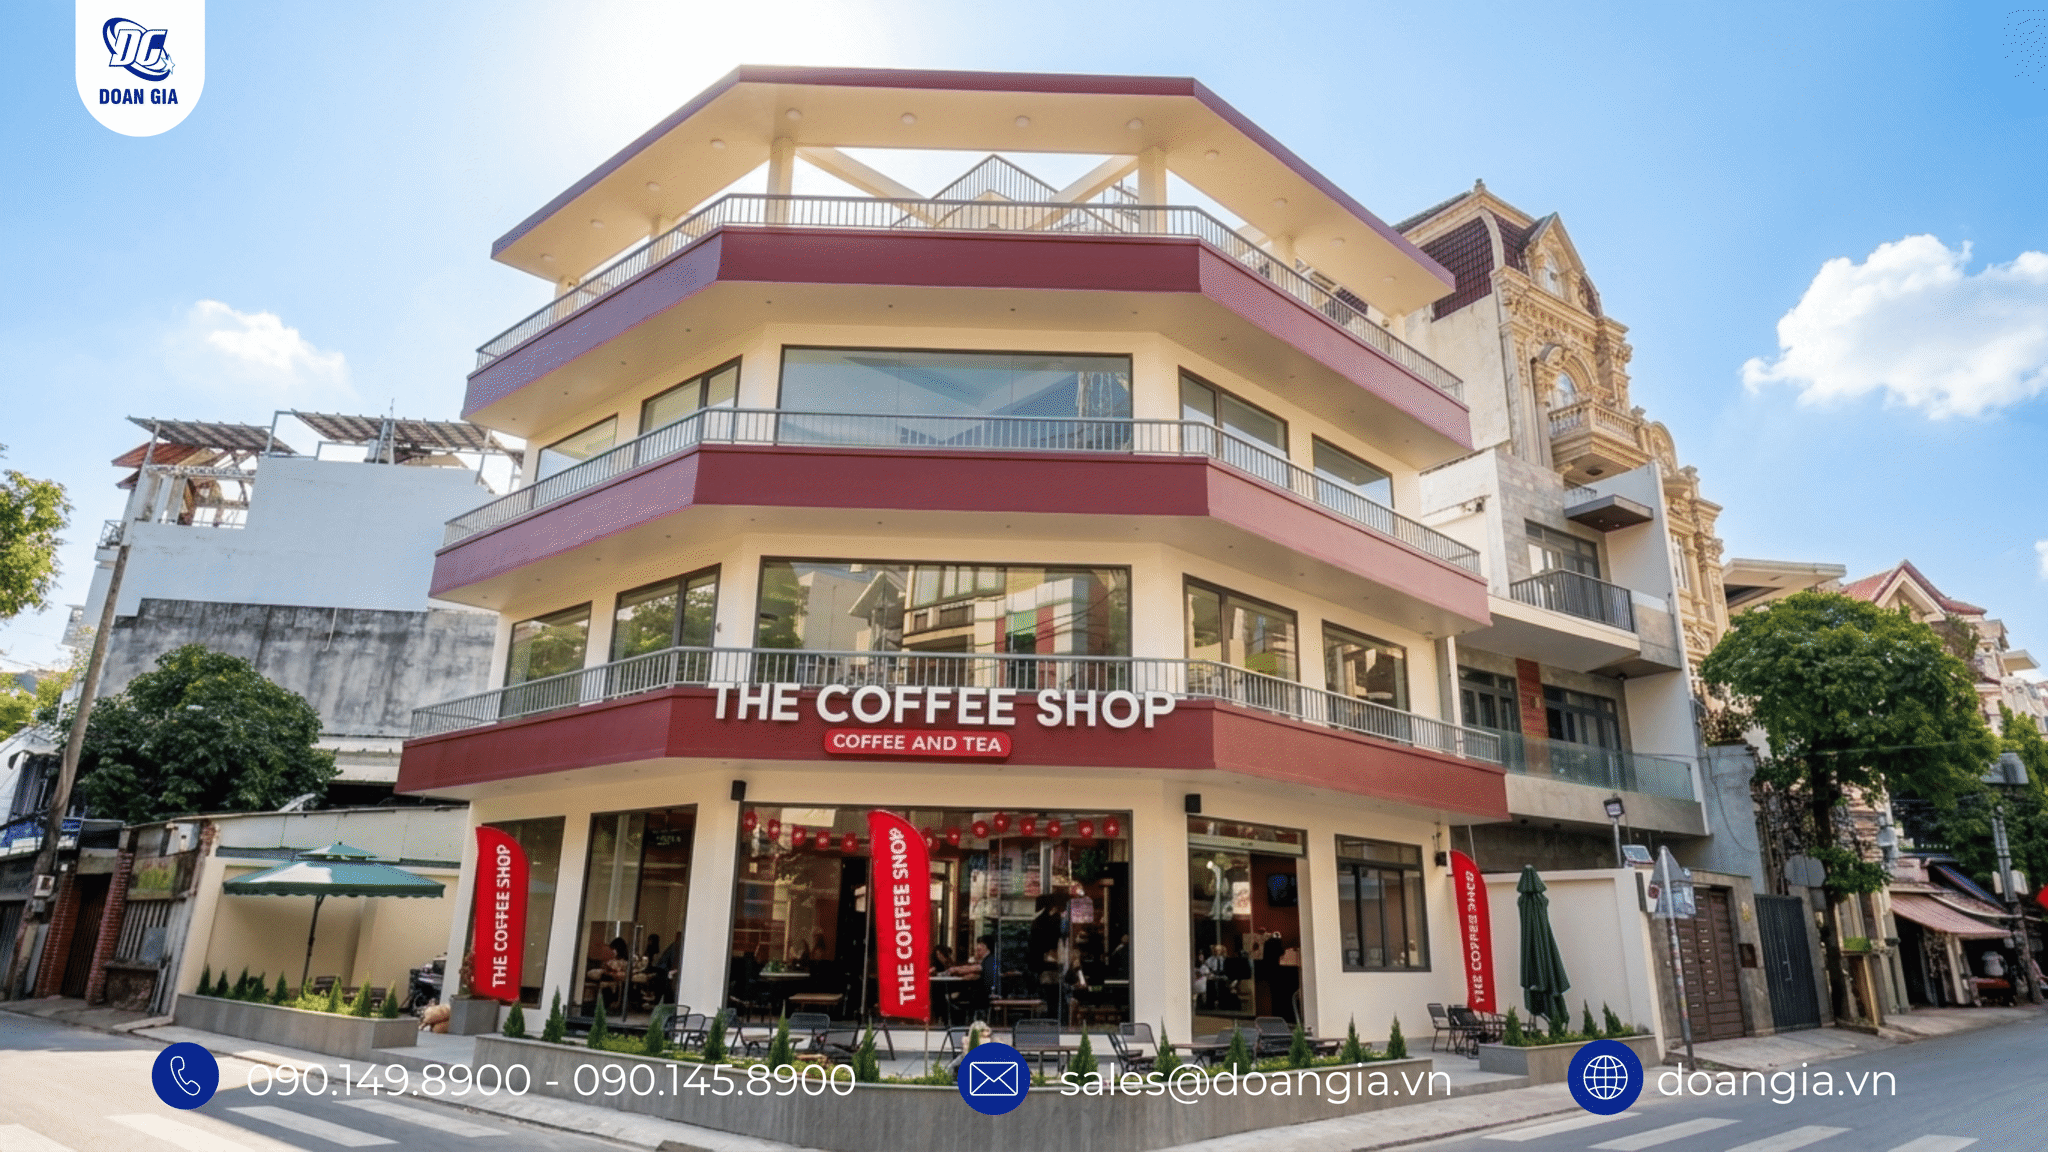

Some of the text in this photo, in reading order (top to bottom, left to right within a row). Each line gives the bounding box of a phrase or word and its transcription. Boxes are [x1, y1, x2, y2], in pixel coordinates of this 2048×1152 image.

[708, 682, 1176, 728] THE COFFEE SHOP
[833, 733, 1002, 753] COFFEE AND TEA
[492, 844, 511, 988] THE COFFEE SHOP
[893, 883, 913, 960] COFFEE
[897, 962, 916, 1005] THE
